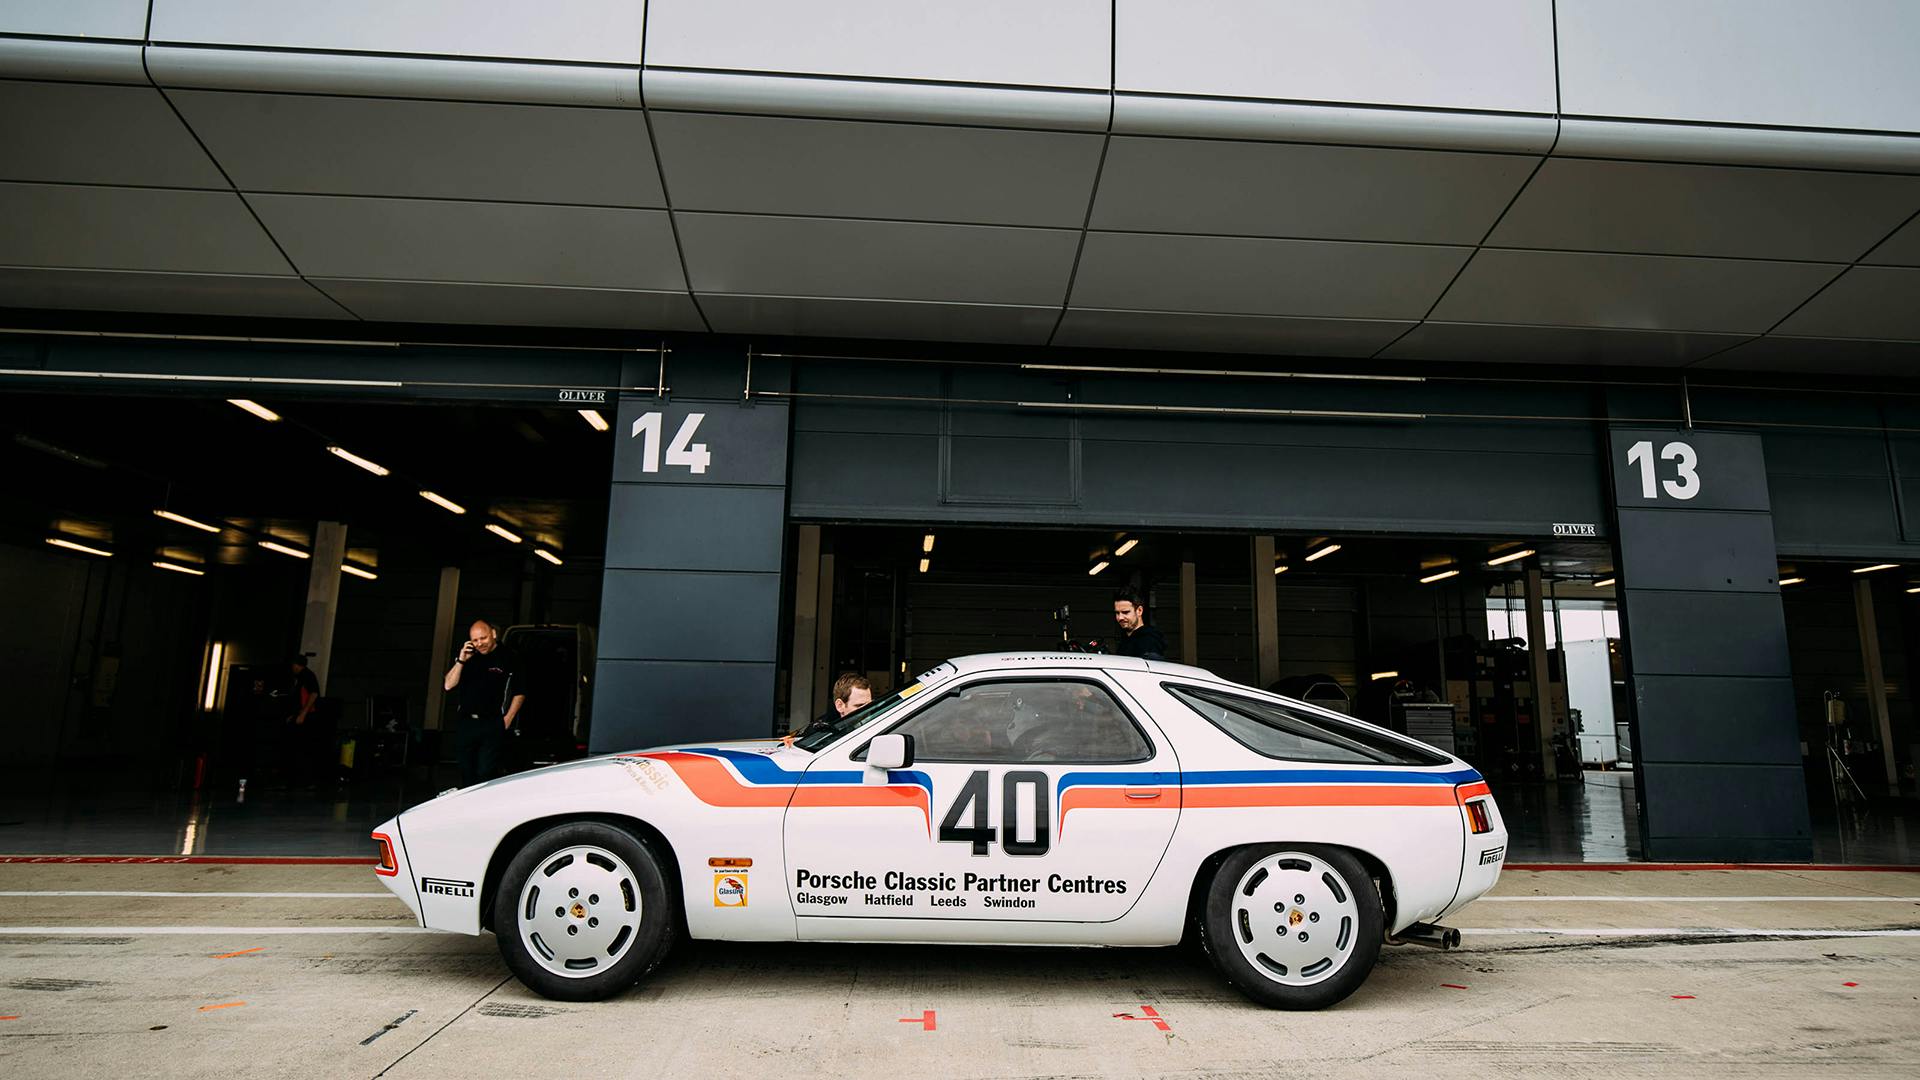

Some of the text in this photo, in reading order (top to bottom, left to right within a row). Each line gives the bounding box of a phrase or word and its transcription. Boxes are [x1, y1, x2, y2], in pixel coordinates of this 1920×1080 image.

[558, 390, 606, 402] OLIVER
[632, 412, 711, 474] 14
[1627, 441, 1700, 500] 13
[1553, 523, 1596, 535] OLIVER
[938, 769, 1051, 857] 40
[1479, 845, 1505, 866] PIRELLI
[421, 877, 475, 898] PIRELLI
[796, 869, 1127, 894] Porsche Classic Partner Centres
[796, 892, 1036, 908] Glasgow Hatfield Leeds Swindon
